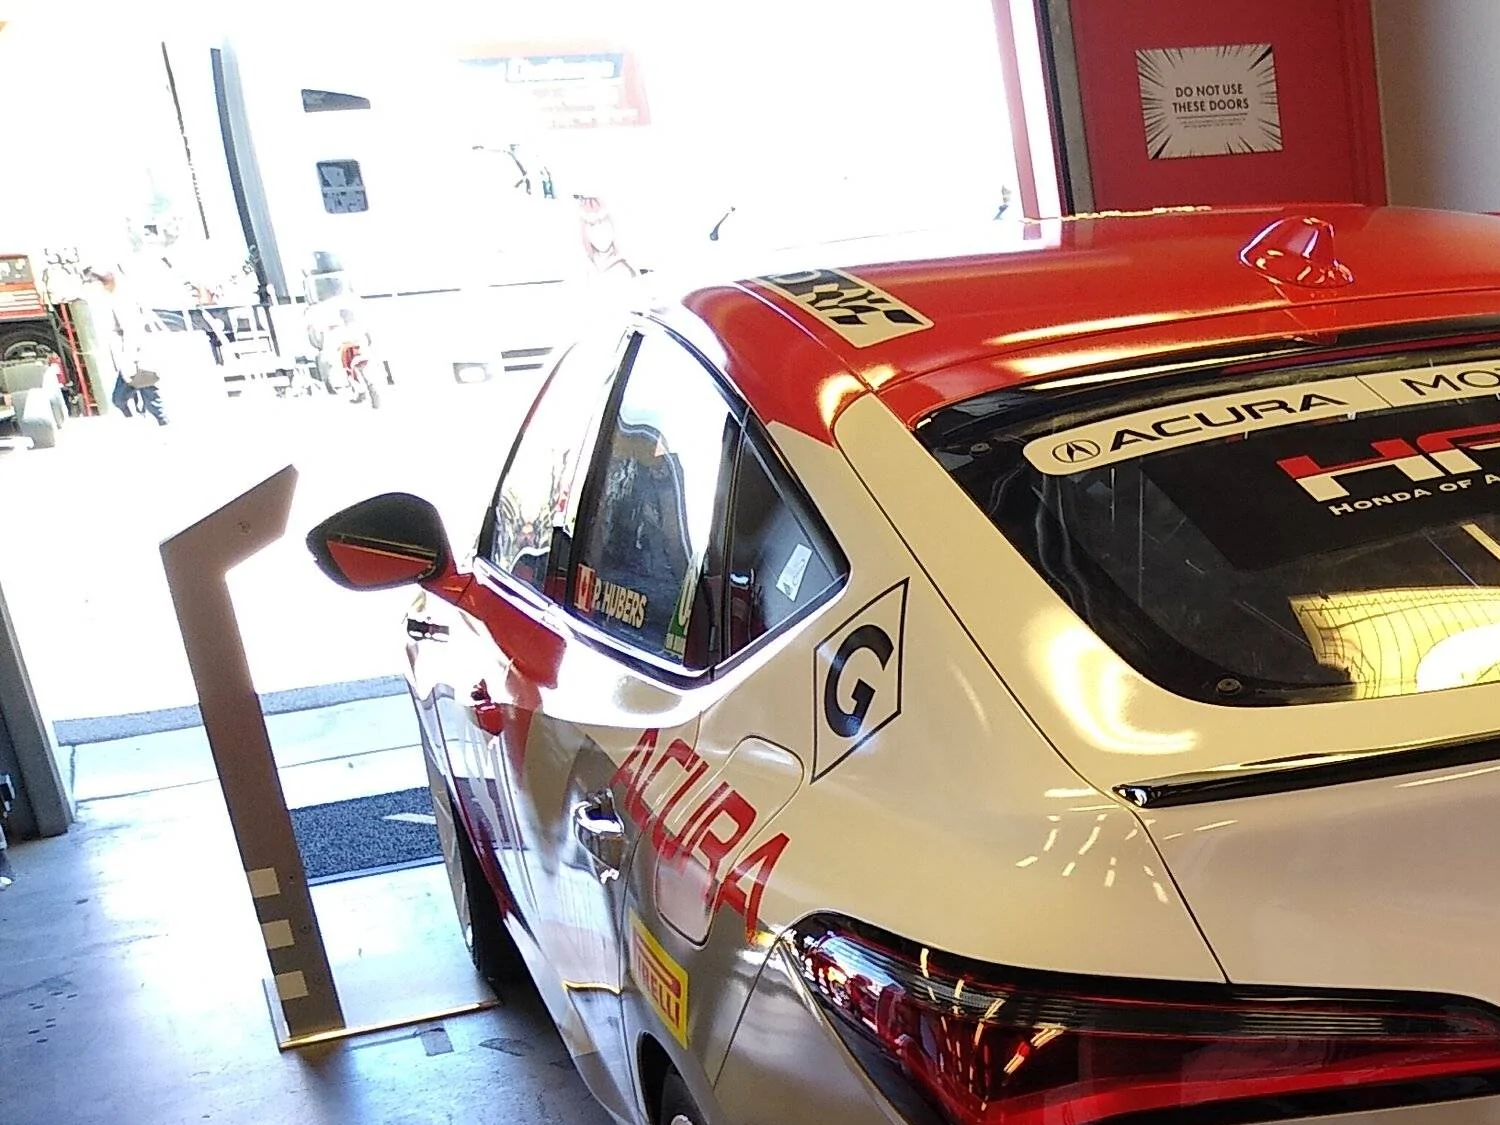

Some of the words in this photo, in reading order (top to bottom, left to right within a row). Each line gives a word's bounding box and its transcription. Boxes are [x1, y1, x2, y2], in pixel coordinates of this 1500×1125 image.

[1172, 101, 1206, 113] THESE
[1209, 99, 1249, 111] DOORS
[1174, 86, 1193, 98] DO
[1196, 84, 1220, 97] NOT
[1223, 83, 1244, 95] USE
[1108, 393, 1351, 452] ACURA
[1329, 486, 1432, 516] HONDA
[1439, 479, 1473, 493] OF
[601, 581, 648, 629] HUBERS
[824, 624, 894, 738] G
[609, 727, 790, 948] ACURA
